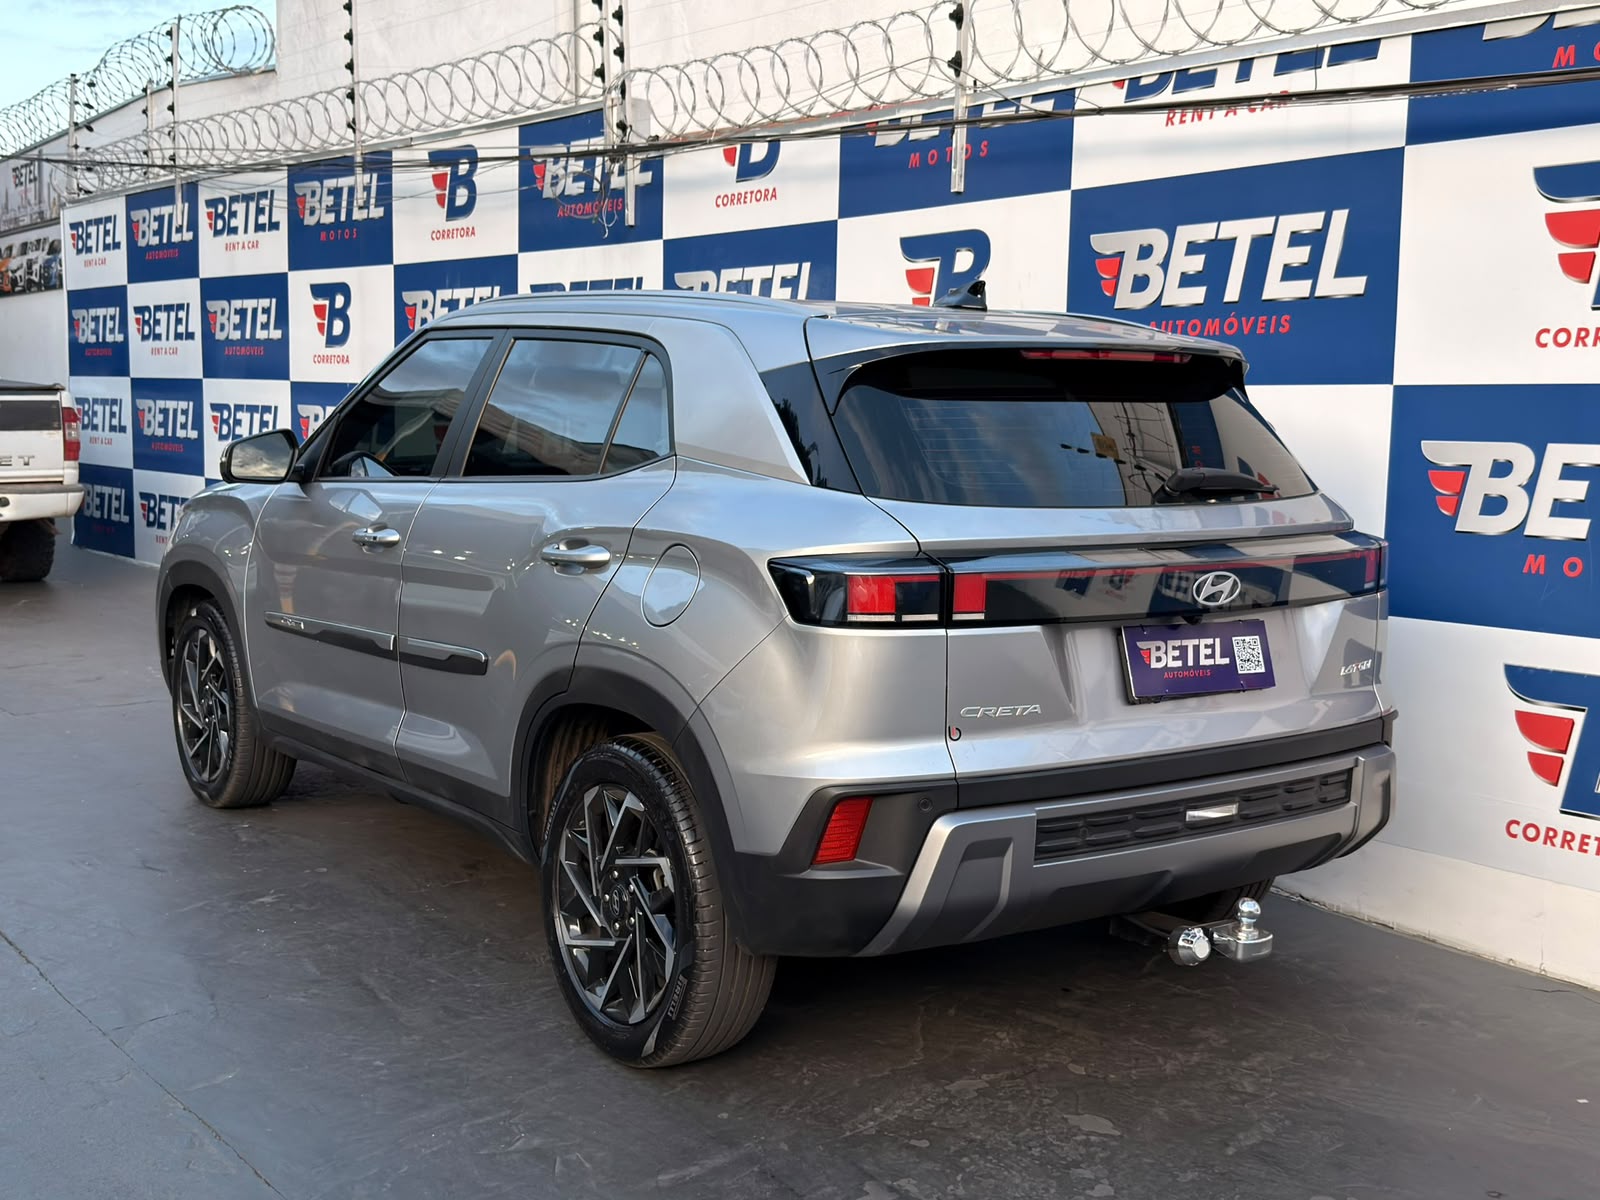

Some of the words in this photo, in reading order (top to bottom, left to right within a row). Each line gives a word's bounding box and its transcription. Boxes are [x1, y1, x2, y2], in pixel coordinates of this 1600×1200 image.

[204, 189, 280, 238] BETEL
[294, 173, 385, 226] BETEL
[715, 187, 777, 208] CORRETORA
[69, 214, 121, 256] BETEL
[225, 241, 240, 252] RENT
[247, 240, 260, 250] CAR
[320, 228, 357, 241] MOTOS
[430, 226, 476, 241] CORRETORA
[1090, 208, 1368, 310] BETEL
[72, 306, 124, 344] BETEL
[133, 302, 196, 342] BETEL
[206, 297, 283, 341] BETEL
[312, 354, 350, 365] CORRETORA
[75, 397, 127, 434] BETEL
[136, 398, 199, 440] BETEL
[83, 483, 130, 524] BETEL
[1136, 637, 1230, 669] BETEL
[1163, 668, 1211, 679] AUTOMÓVEIS
[960, 704, 1042, 719] CRETA
